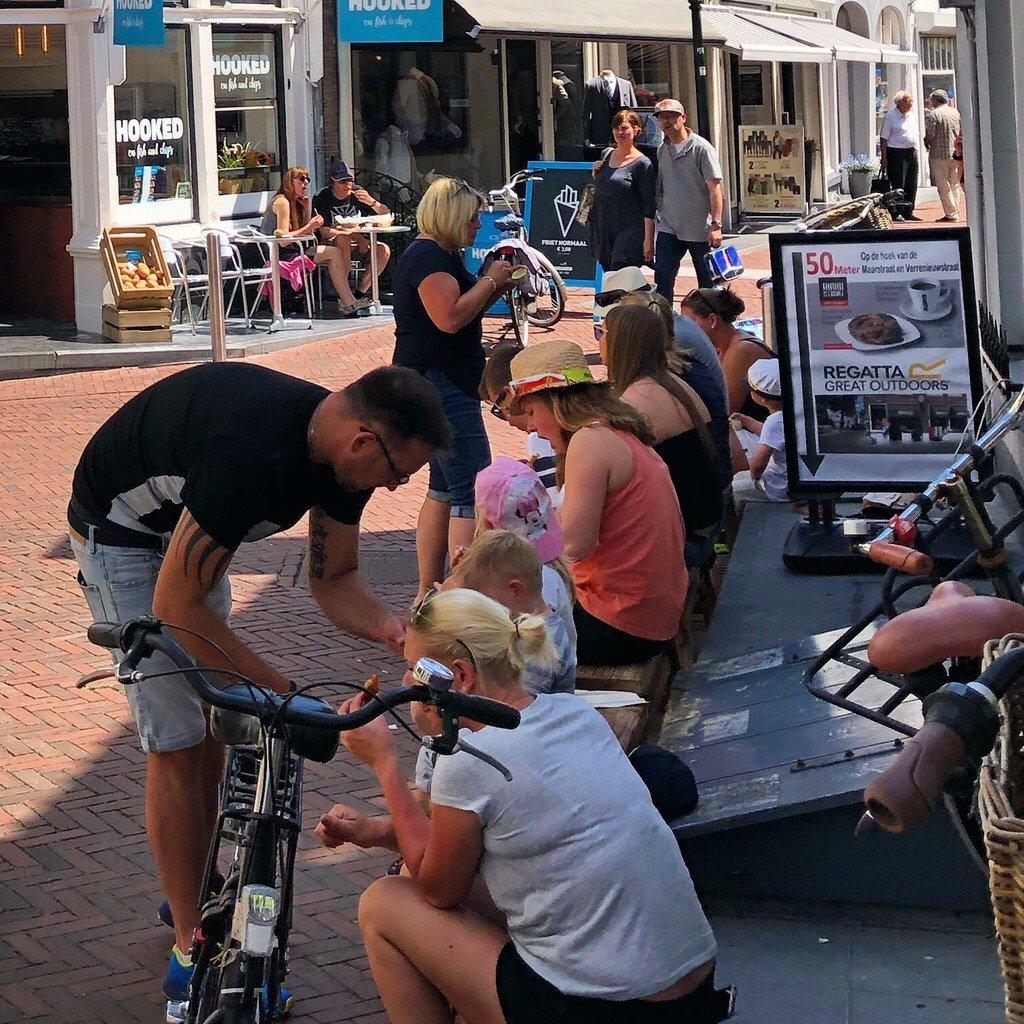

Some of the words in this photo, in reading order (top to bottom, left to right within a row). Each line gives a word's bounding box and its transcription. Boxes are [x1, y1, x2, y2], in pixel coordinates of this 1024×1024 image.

[212, 54, 270, 76] HOOKED
[228, 77, 237, 92] fish
[249, 77, 262, 93] chips
[116, 117, 184, 142] HOOKED
[137, 143, 147, 159] fish
[148, 143, 159, 155] and
[160, 142, 174, 158] chips
[748, 161, 754, 169] 2
[774, 200, 780, 208] 2
[806, 251, 833, 275] 50
[834, 265, 861, 274] Meter
[860, 251, 870, 262] Op
[871, 252, 879, 260] de
[880, 251, 896, 260] hoek
[897, 252, 908, 260] van
[910, 251, 917, 259] de
[905, 263, 960, 273] Verrenieuwstraat
[823, 365, 905, 379] REGATTA
[824, 380, 867, 392] GREAT
[869, 379, 949, 391] OUTDOORS
